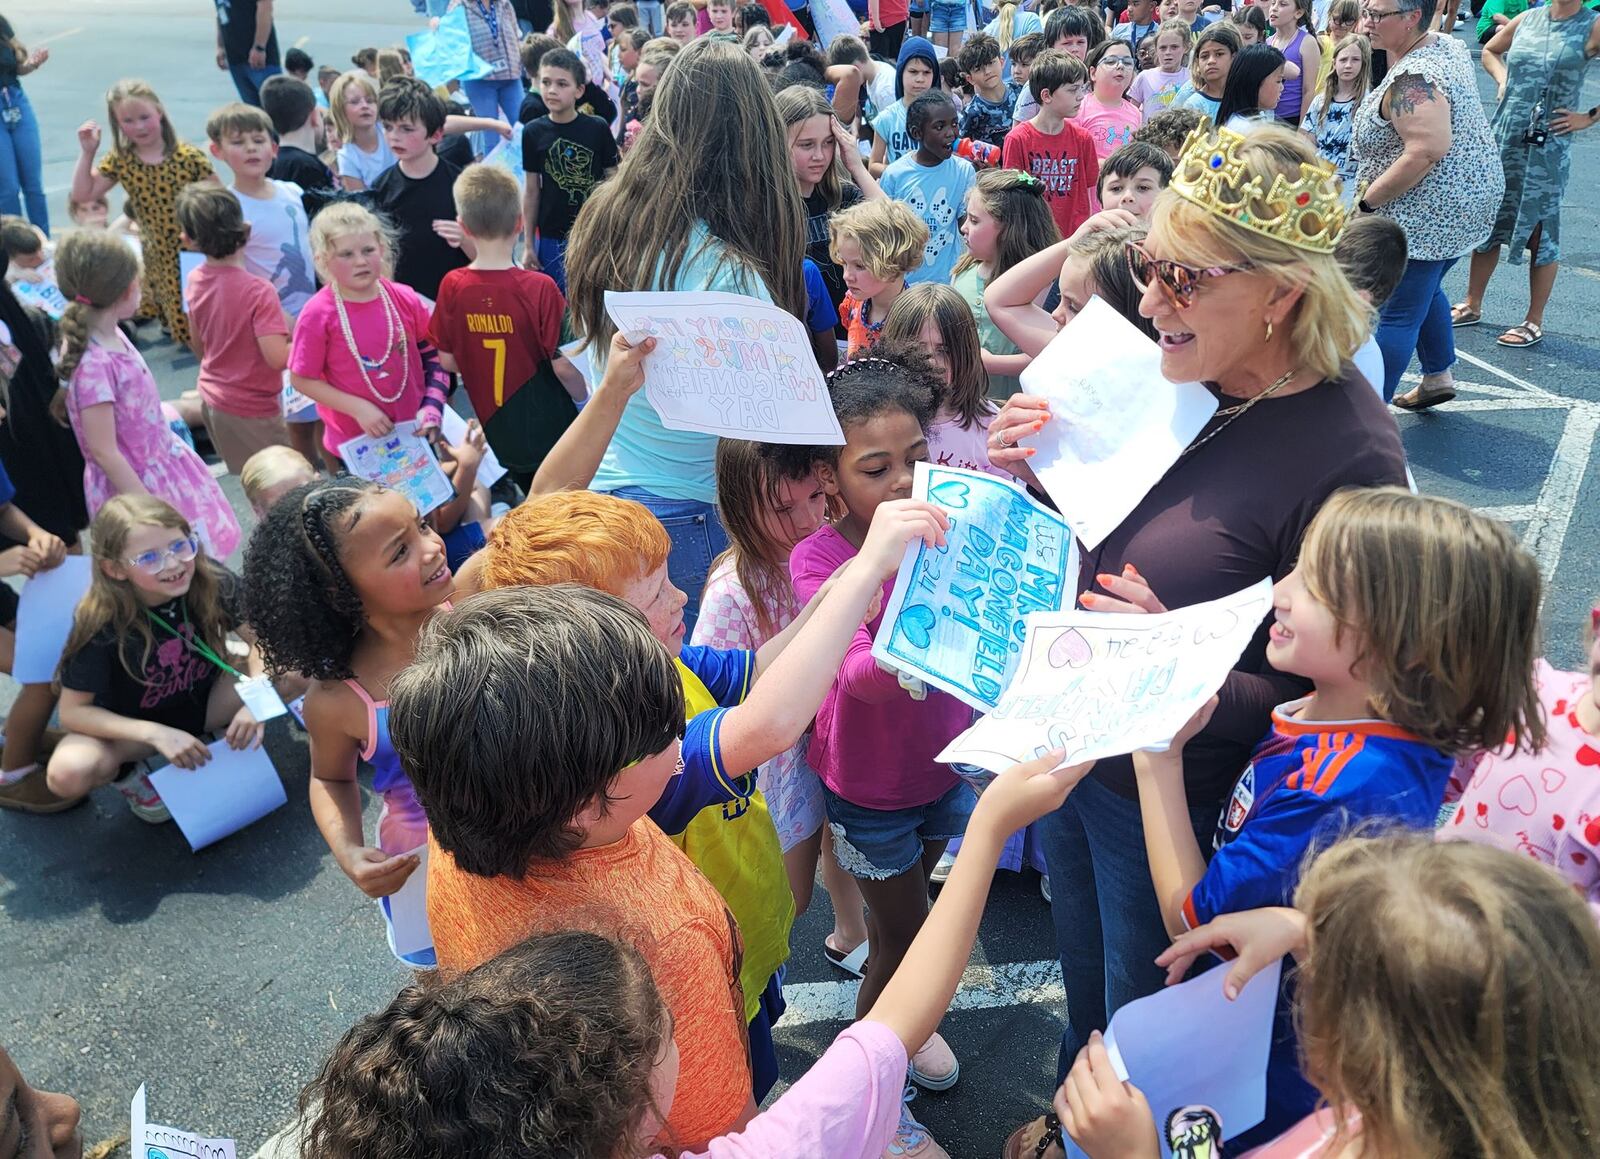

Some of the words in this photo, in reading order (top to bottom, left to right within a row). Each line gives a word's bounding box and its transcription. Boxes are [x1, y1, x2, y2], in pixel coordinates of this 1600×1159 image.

[1031, 158, 1078, 175] BEAST
[466, 313, 514, 334] RONALDO
[483, 338, 507, 407] 7
[940, 523, 997, 634] DAY!
[971, 496, 1036, 703] WAGONFIELD
